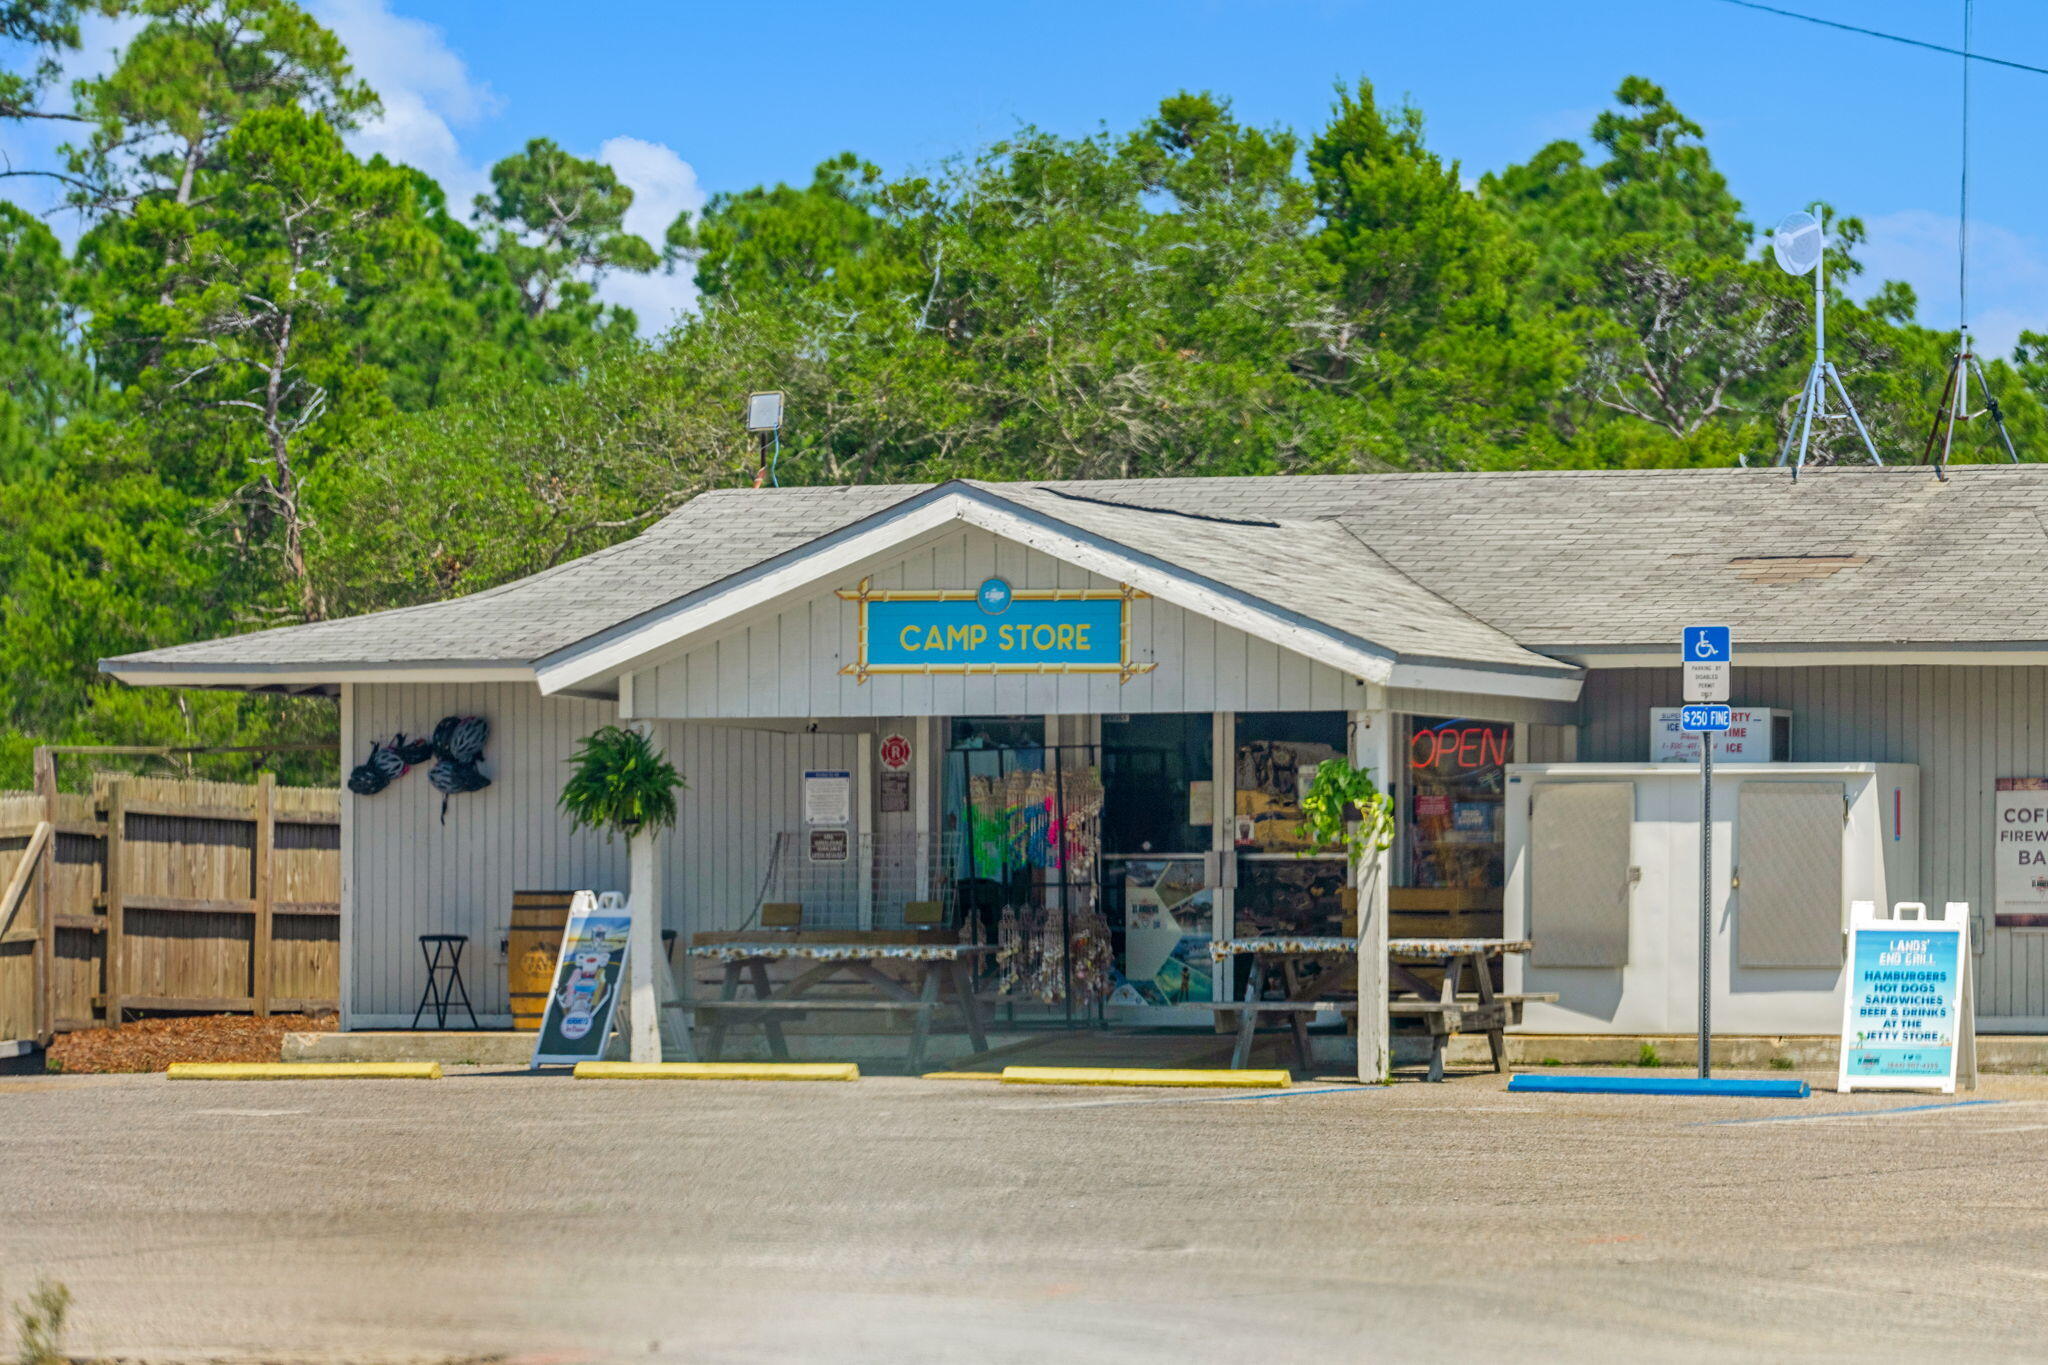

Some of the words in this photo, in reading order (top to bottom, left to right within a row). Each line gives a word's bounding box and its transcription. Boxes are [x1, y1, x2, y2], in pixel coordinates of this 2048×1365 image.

[900, 624, 987, 651] CAMP
[998, 624, 1091, 651] STORE
[1683, 711, 1707, 726] $250
[1710, 711, 1729, 726] FINE
[1667, 723, 1680, 731] ICE
[892, 747, 900, 758] R
[1409, 728, 1508, 768] OPEN
[1726, 743, 1743, 753] ICE
[2004, 808, 2048, 823] COF
[2018, 850, 2046, 865] BA
[1879, 952, 1900, 966] END
[1905, 953, 1936, 966] GRILL
[1864, 971, 1947, 981] HAMBURGERS
[1874, 983, 1898, 992] HOT
[1901, 983, 1935, 993] DOGS
[1865, 994, 1943, 1005] SANDWICHES
[1860, 1007, 1887, 1016] BEER
[1891, 1007, 1898, 1016] &
[1902, 1008, 1946, 1017] DRINKS
[1883, 1020, 1897, 1028] AT
[1901, 1020, 1922, 1028] THE
[1866, 1031, 1898, 1040] JETTY
[1902, 1031, 1938, 1040] STORE
